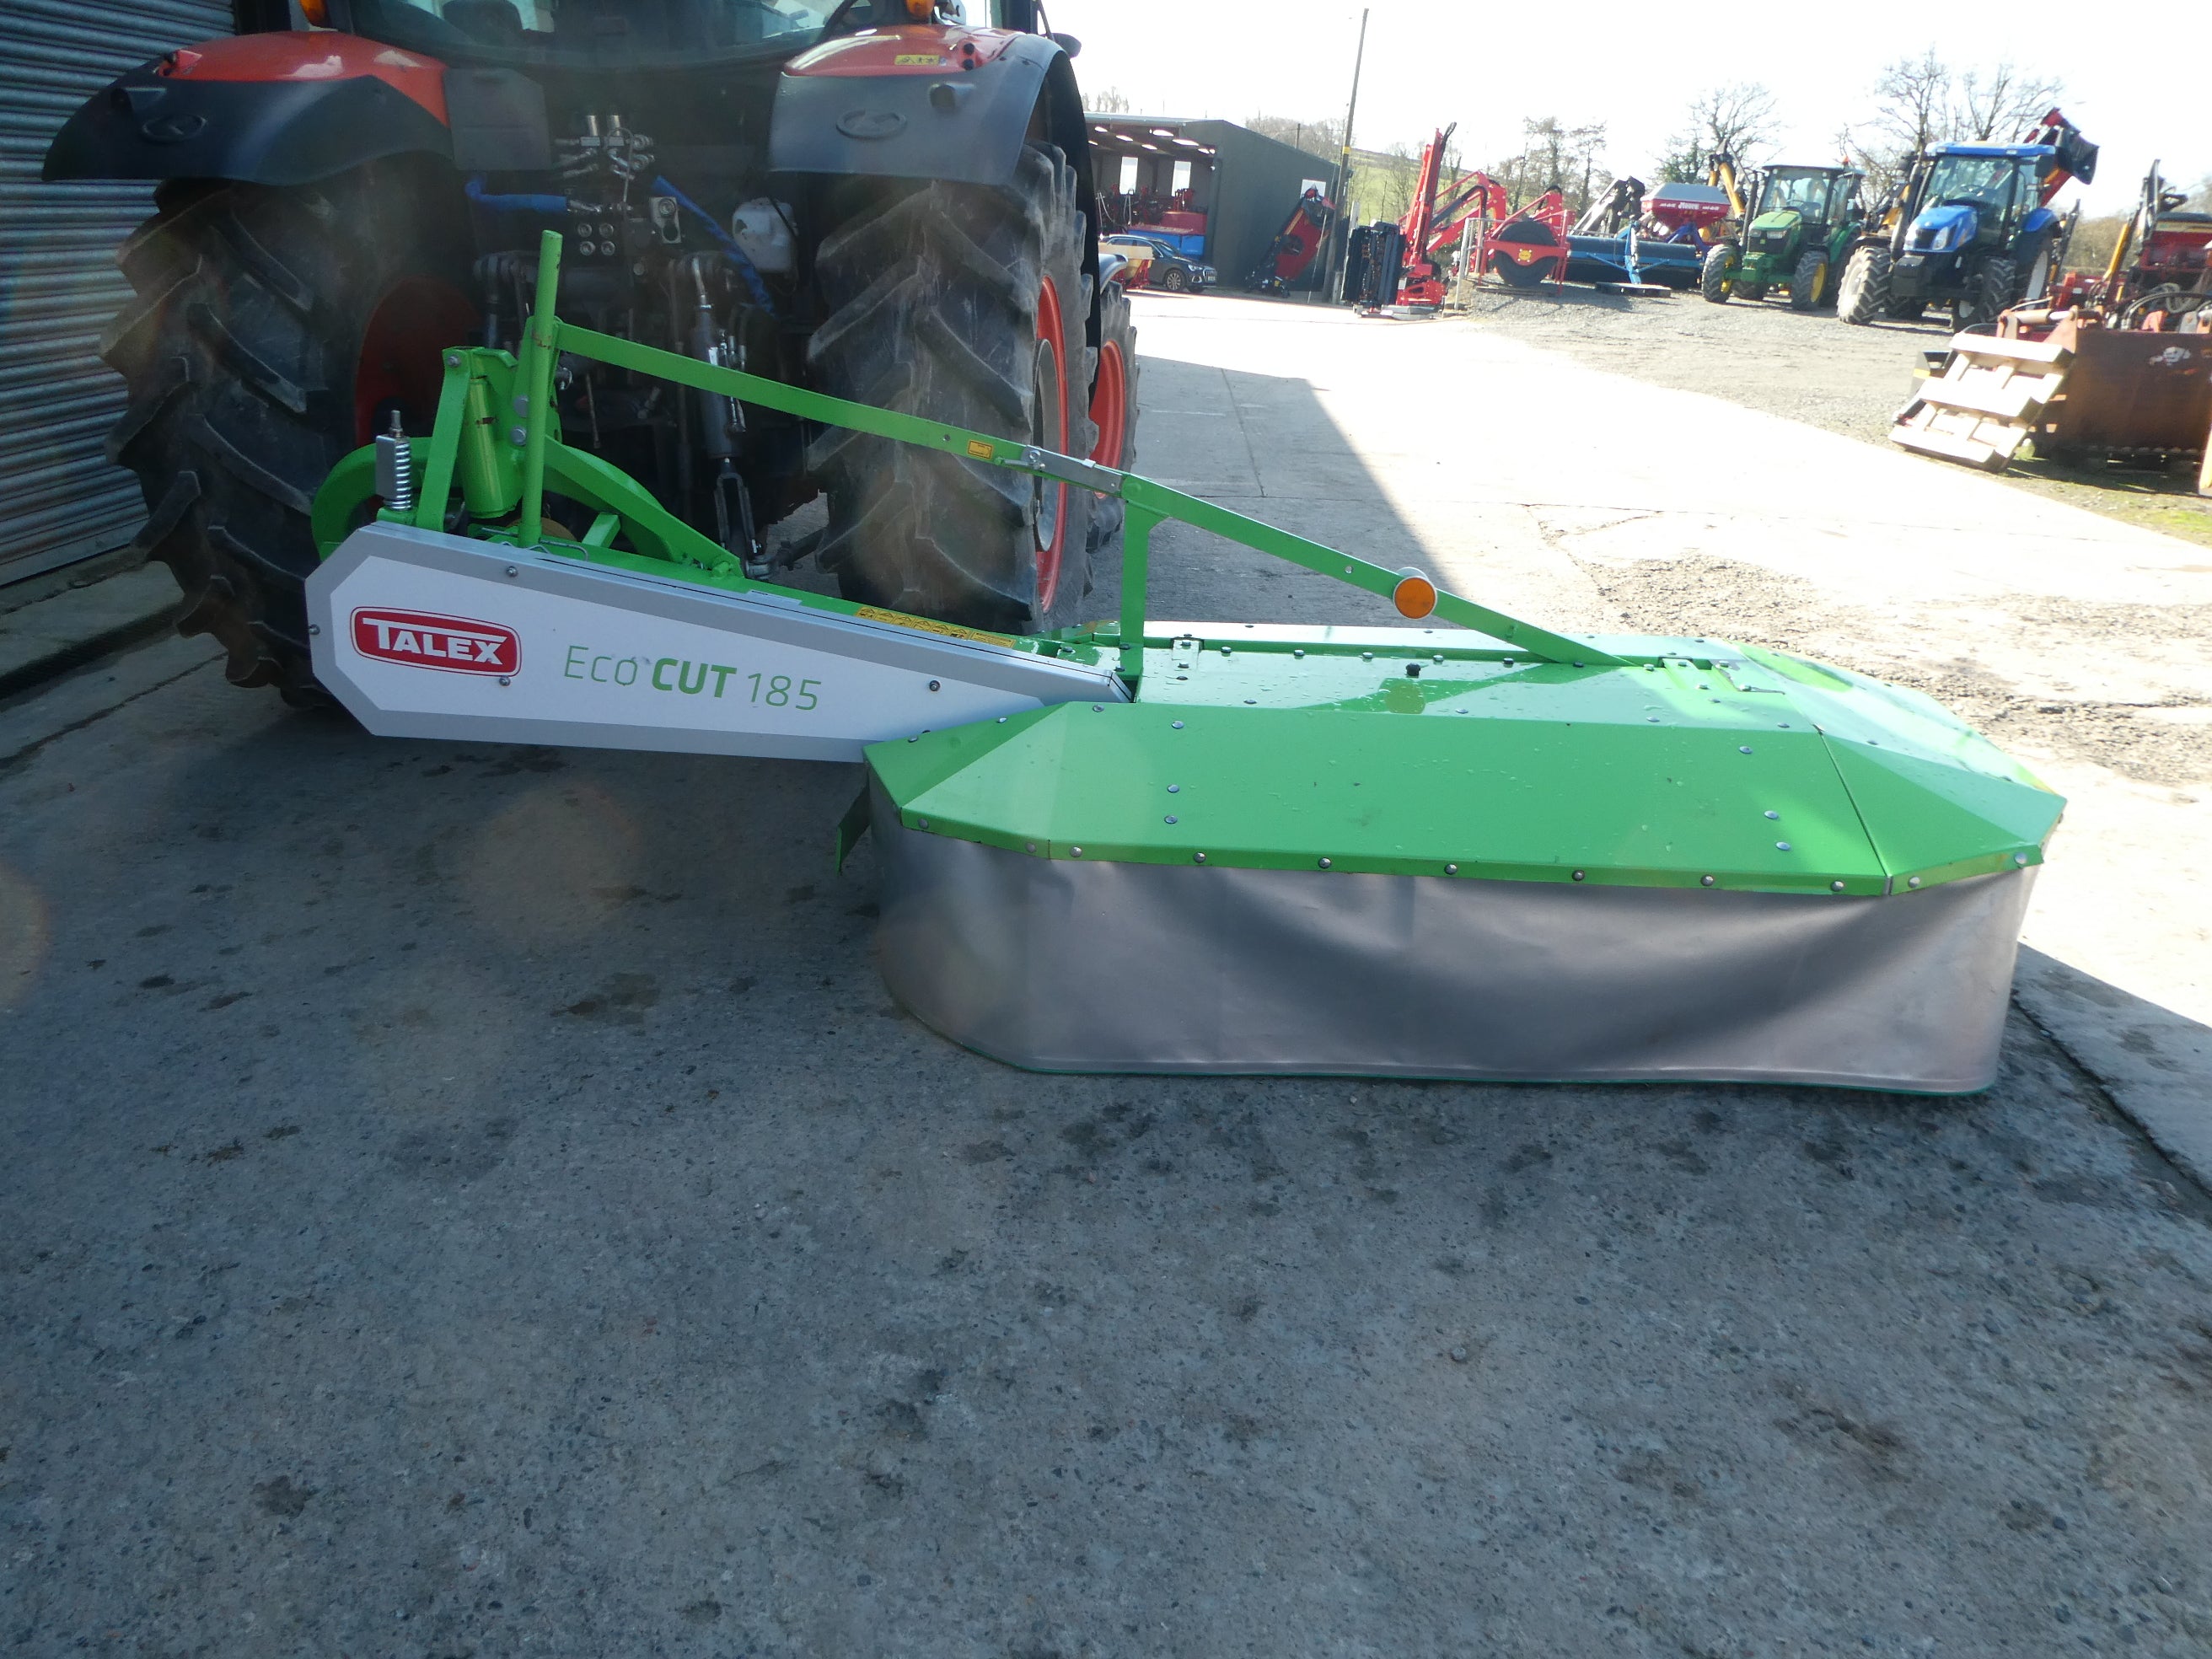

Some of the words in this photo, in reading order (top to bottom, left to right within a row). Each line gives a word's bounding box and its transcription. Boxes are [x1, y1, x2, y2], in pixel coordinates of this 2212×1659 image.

[362, 617, 507, 665] TALEX
[652, 658, 738, 698] CUT
[748, 673, 822, 711] 185
